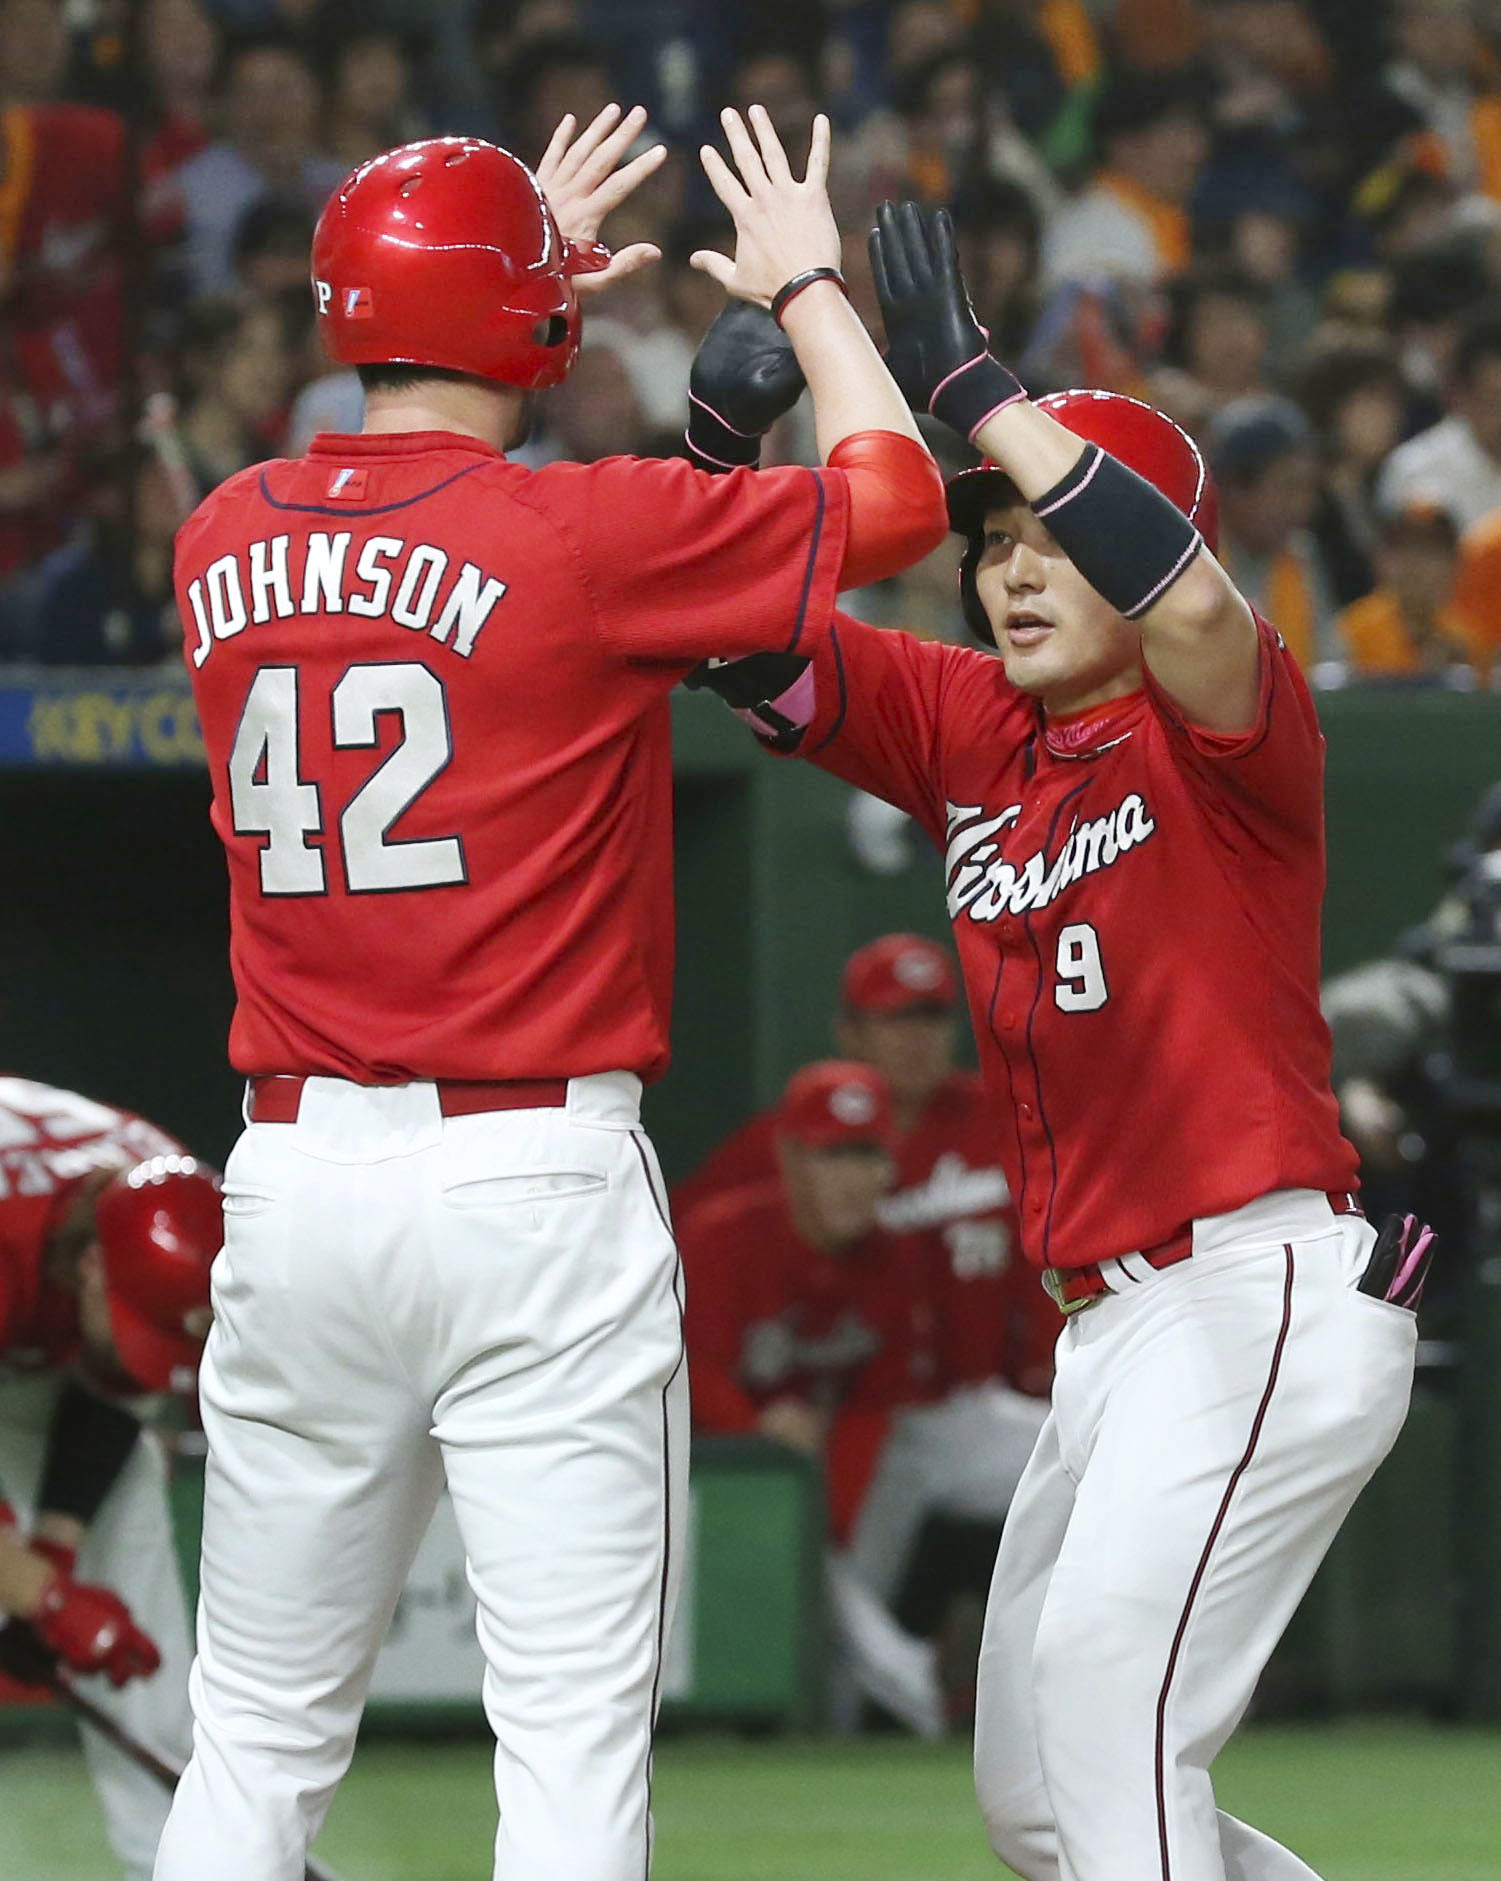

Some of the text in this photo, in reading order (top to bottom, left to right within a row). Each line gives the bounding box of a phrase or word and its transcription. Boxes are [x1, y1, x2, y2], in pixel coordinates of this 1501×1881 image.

[187, 531, 508, 669] JOHNSON
[227, 660, 469, 897] 42
[1055, 922, 1108, 1012] 9
